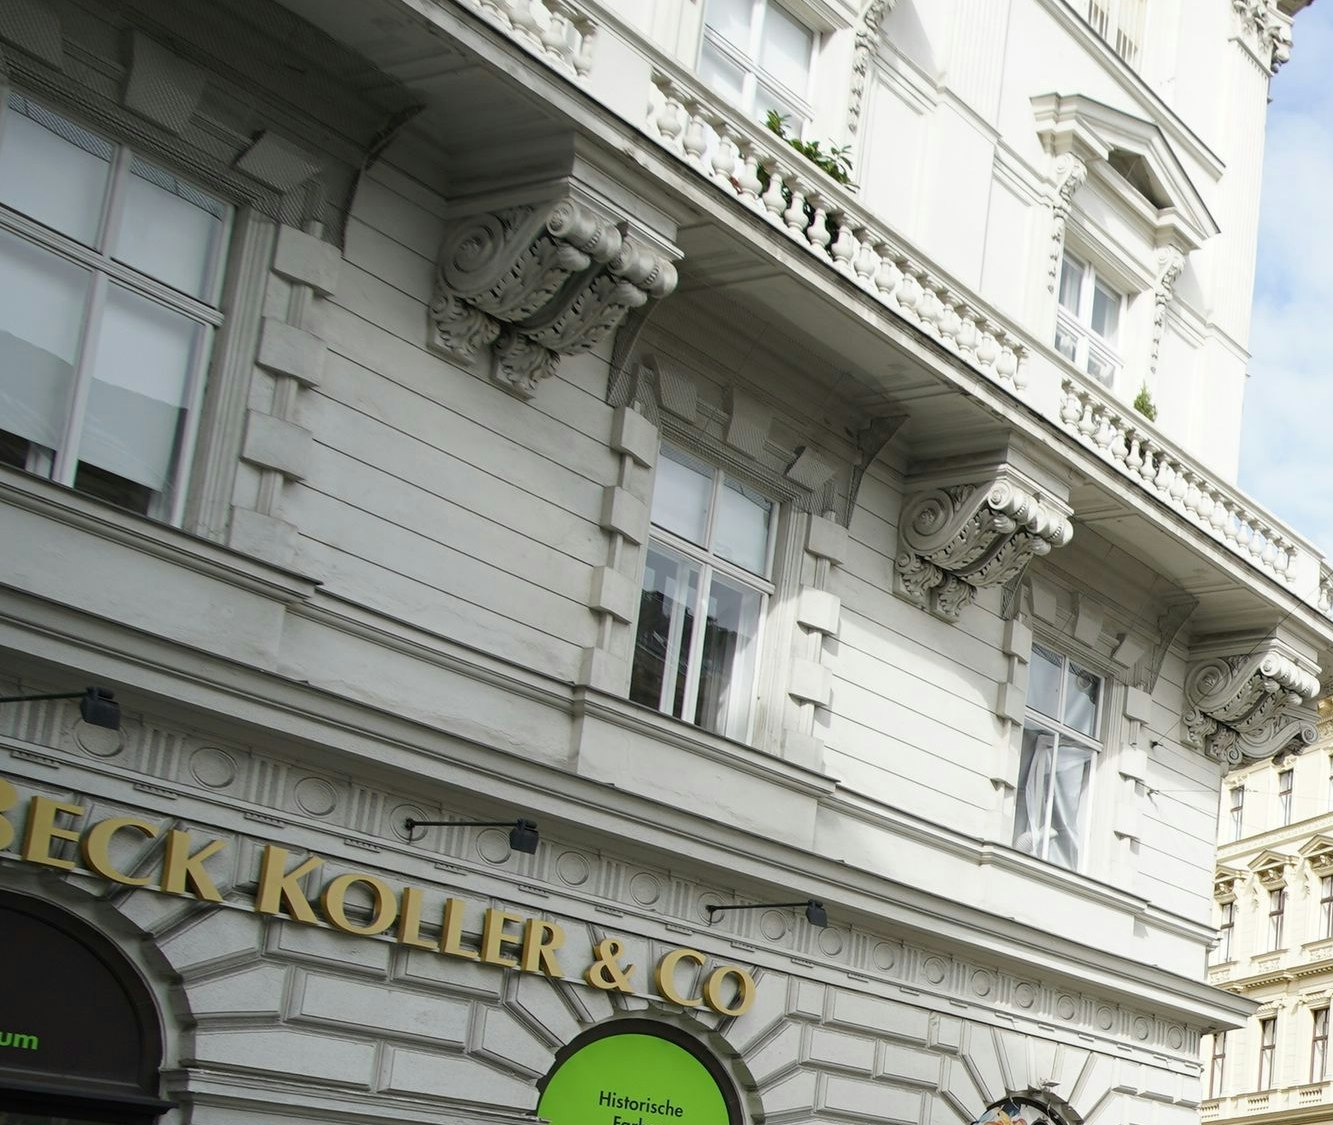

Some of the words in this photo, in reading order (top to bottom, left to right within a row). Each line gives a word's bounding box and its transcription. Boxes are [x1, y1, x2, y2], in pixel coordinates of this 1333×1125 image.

[255, 845, 565, 978] KOLLER
[585, 938, 636, 994] &
[656, 949, 756, 1017] CO
[599, 1090, 683, 1117] Historische
